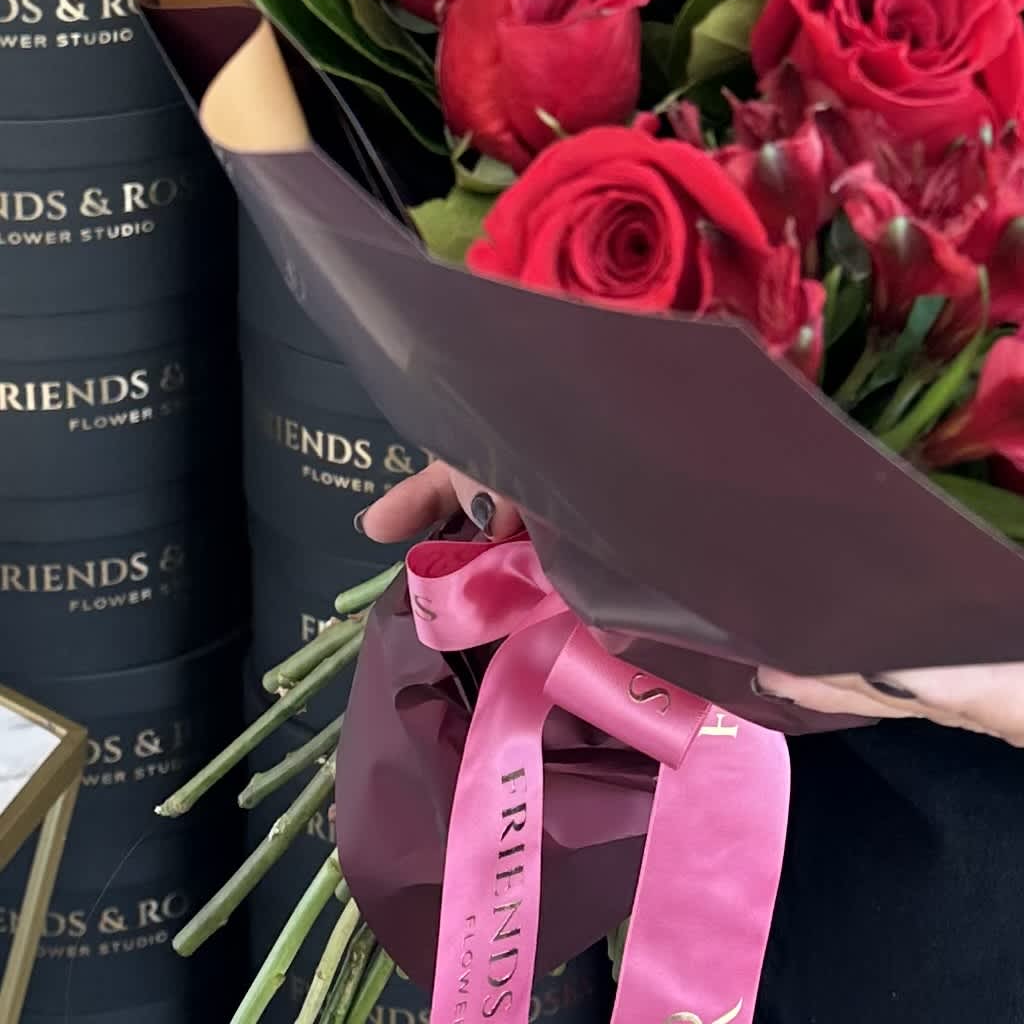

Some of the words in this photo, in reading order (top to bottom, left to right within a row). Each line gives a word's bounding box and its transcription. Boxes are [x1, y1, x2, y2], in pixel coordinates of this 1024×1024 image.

[56, 27, 133, 48] STUDIO
[80, 187, 113, 217] &
[122, 180, 185, 213] RO
[80, 220, 155, 242] STUDIO
[68, 407, 153, 432] FLOWER
[383, 443, 414, 474] &
[302, 465, 375, 493] FLOWER
[1, 552, 149, 593] RIENDS
[68, 588, 153, 612] FLOWER
[134, 729, 163, 757] &
[482, 768, 527, 1018] FRIENDS
[99, 906, 128, 934] &
[100, 929, 168, 956] STUDIO
